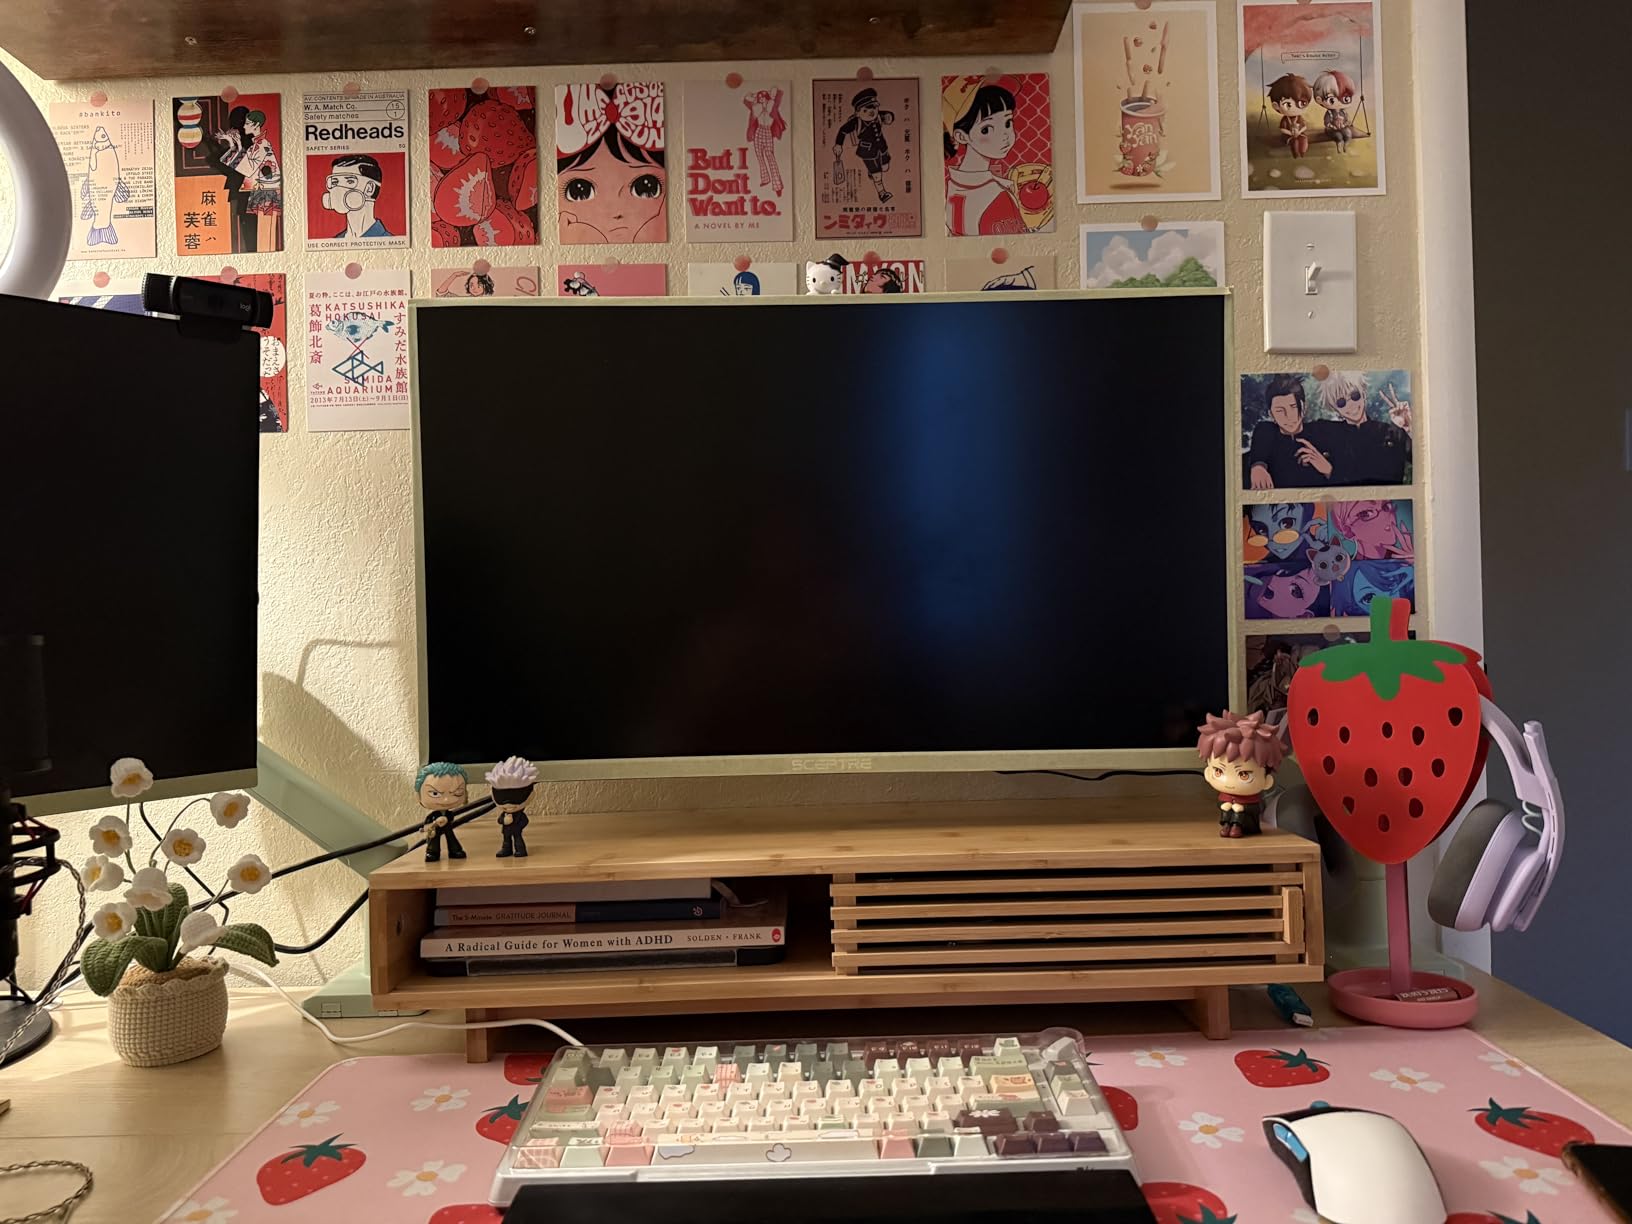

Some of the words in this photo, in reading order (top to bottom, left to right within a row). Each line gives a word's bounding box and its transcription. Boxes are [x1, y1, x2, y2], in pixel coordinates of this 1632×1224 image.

[305, 122, 404, 141] Redheads
[688, 148, 734, 171] But
[738, 148, 749, 170] I
[687, 195, 748, 217] Want
[750, 195, 782, 216] to.
[184, 211, 201, 250] 芙蓉
[325, 301, 405, 312] KATSUSHIKA
[326, 311, 381, 321] HOKUSAI
[394, 312, 408, 394] すみだ水族館
[327, 386, 393, 395] AQUARIUM
[792, 758, 872, 771] SCEPTRE
[496, 911, 535, 920] GRATITUDE
[445, 943, 453, 952] A
[458, 941, 500, 952] Radical
[504, 939, 538, 951] Guide
[542, 938, 559, 949] for
[562, 937, 603, 948] Women
[607, 936, 632, 947] with
[635, 934, 673, 946] ADHD
[687, 934, 722, 942] SOLDEN
[733, 933, 762, 941] FRANK
